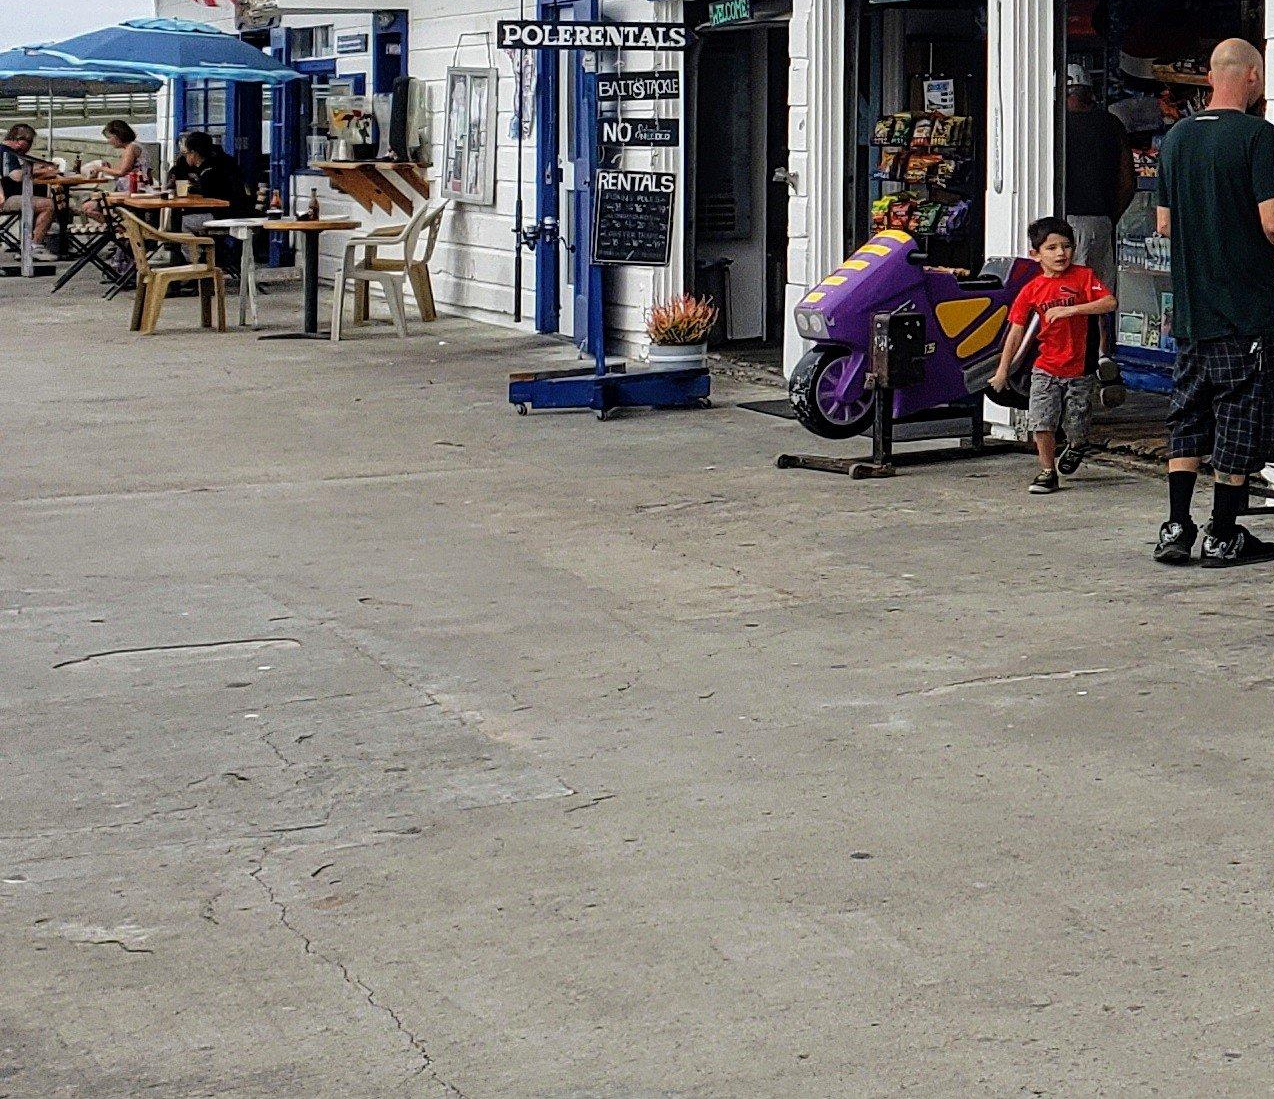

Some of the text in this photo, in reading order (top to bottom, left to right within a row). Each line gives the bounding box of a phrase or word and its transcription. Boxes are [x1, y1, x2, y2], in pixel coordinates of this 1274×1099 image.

[712, 0, 748, 26] WELCOME
[599, 81, 634, 96] BAIT
[645, 79, 678, 95] TACKLE
[603, 122, 632, 142] NO
[598, 172, 675, 192] RENTALS
